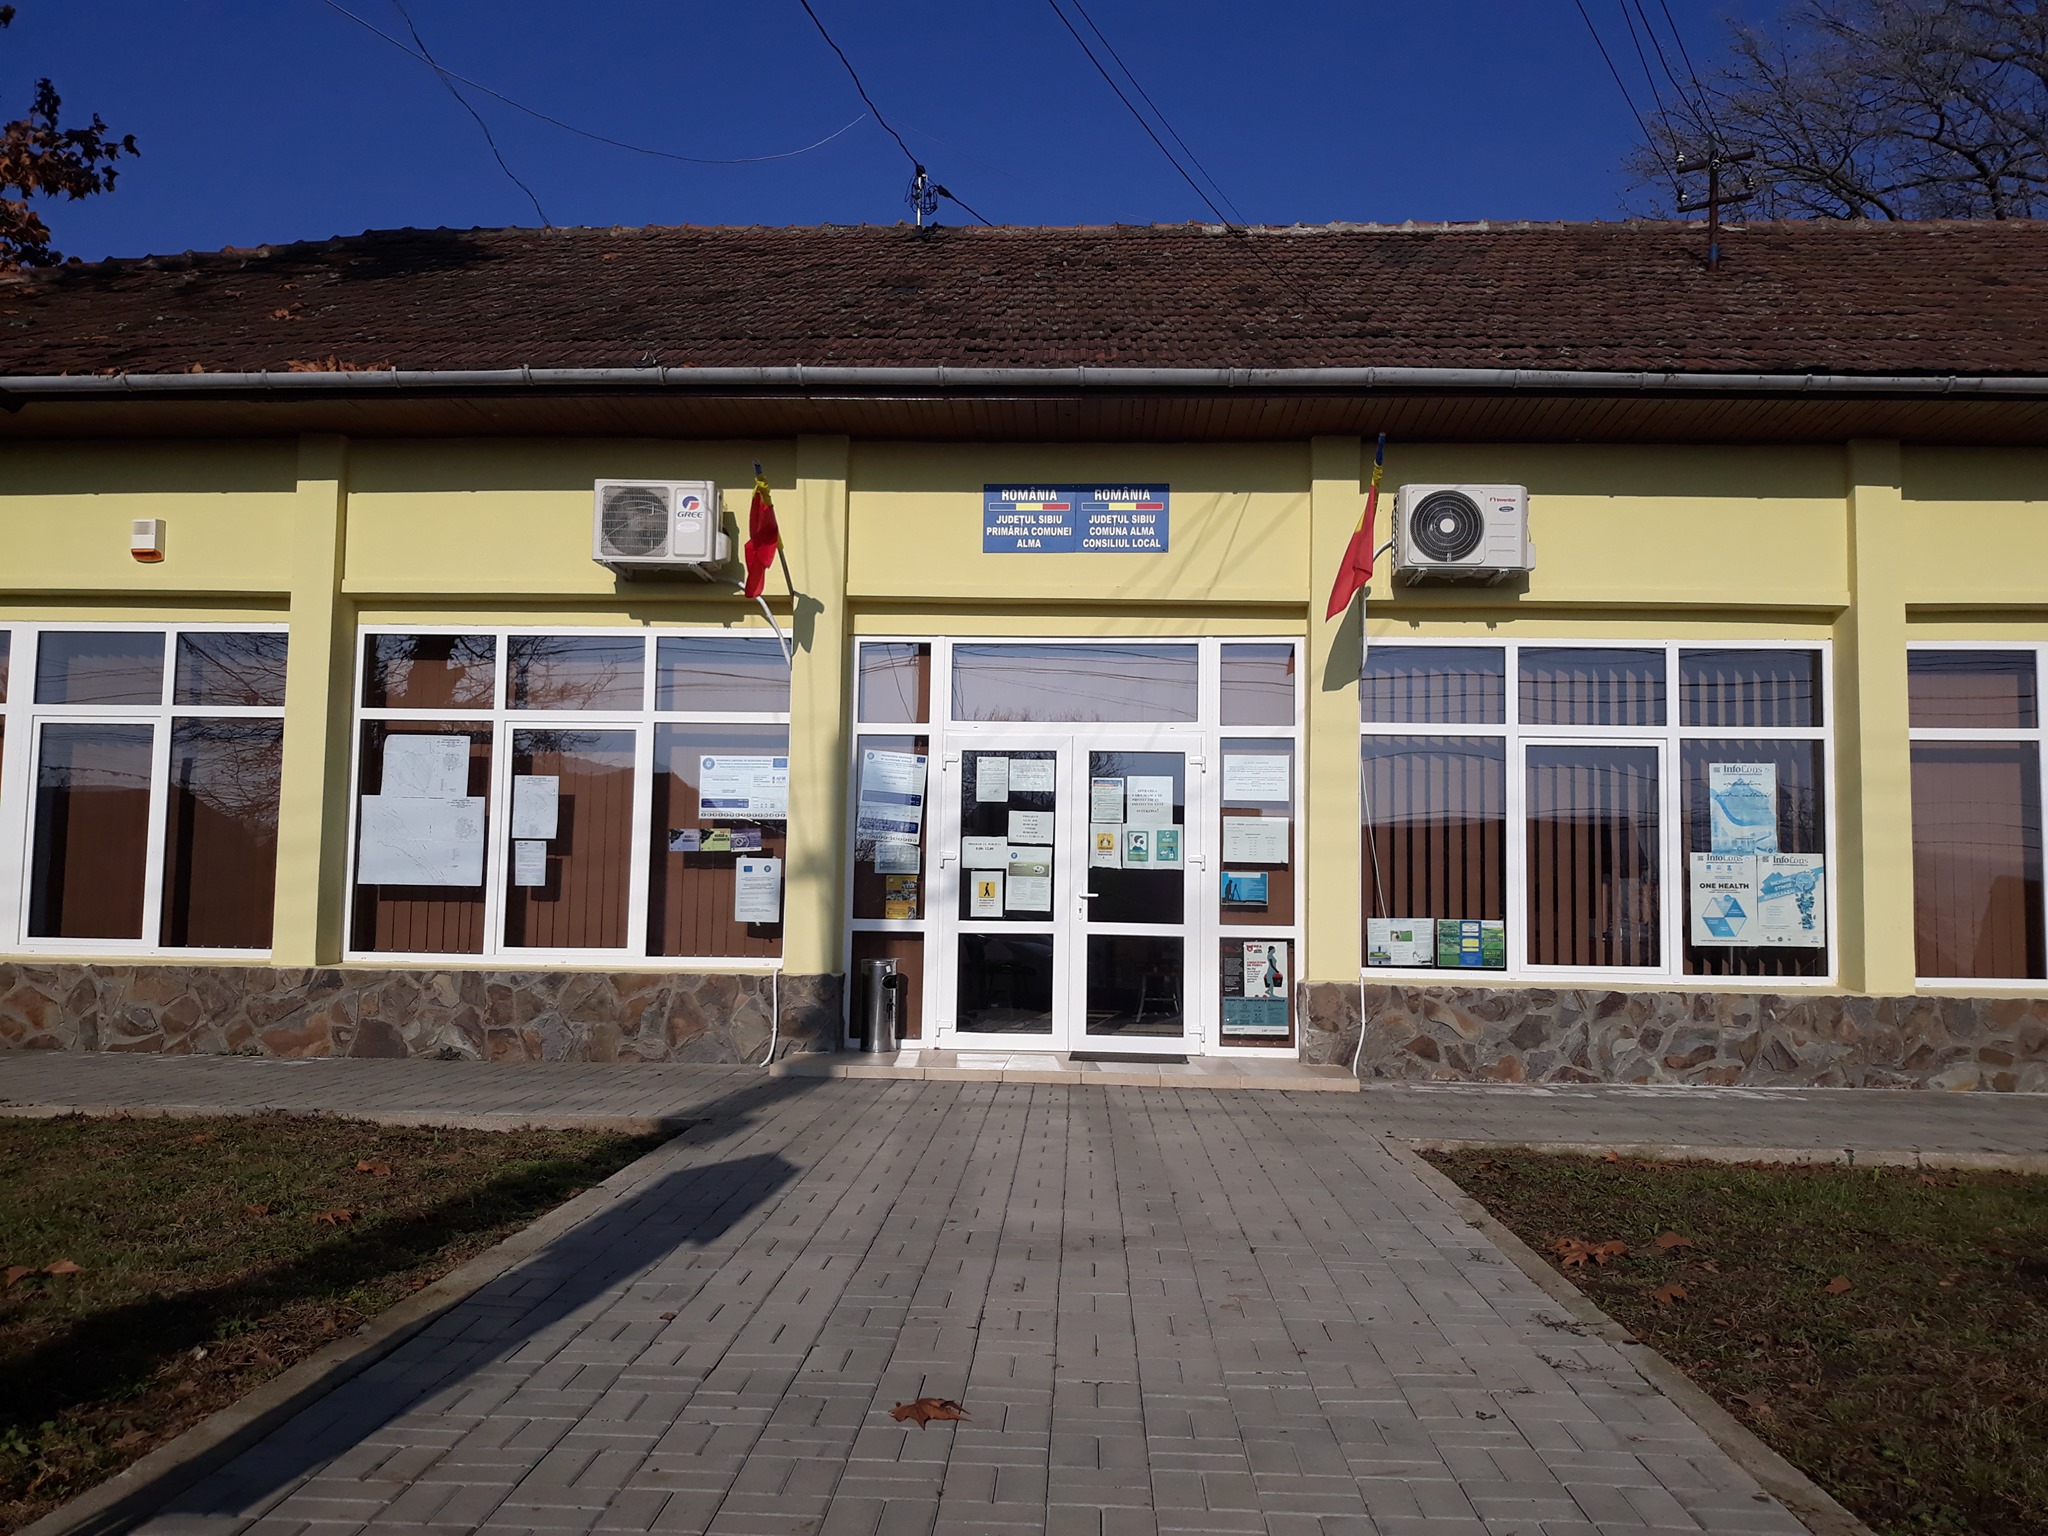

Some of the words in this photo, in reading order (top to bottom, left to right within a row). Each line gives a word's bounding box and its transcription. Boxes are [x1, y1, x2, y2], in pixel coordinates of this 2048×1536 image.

[1001, 487, 1058, 501] ROMÂNIA
[1094, 487, 1151, 501] ROMÂNIA
[677, 511, 704, 519] GREE
[1038, 515, 1063, 524] SIBIU
[1131, 515, 1156, 524] SIBIU
[986, 525, 1029, 536] PRIMĂRIA
[1031, 526, 1072, 536] COMUNEI
[1089, 526, 1128, 536] COMUNA
[1130, 526, 1155, 536] ALMA
[1016, 538, 1041, 548] ALMA
[1082, 538, 1130, 548] CONSILIUL
[1132, 538, 1161, 548] LOCAL
[1723, 764, 1763, 773] InfoCons
[1773, 856, 1809, 864] InfoCons
